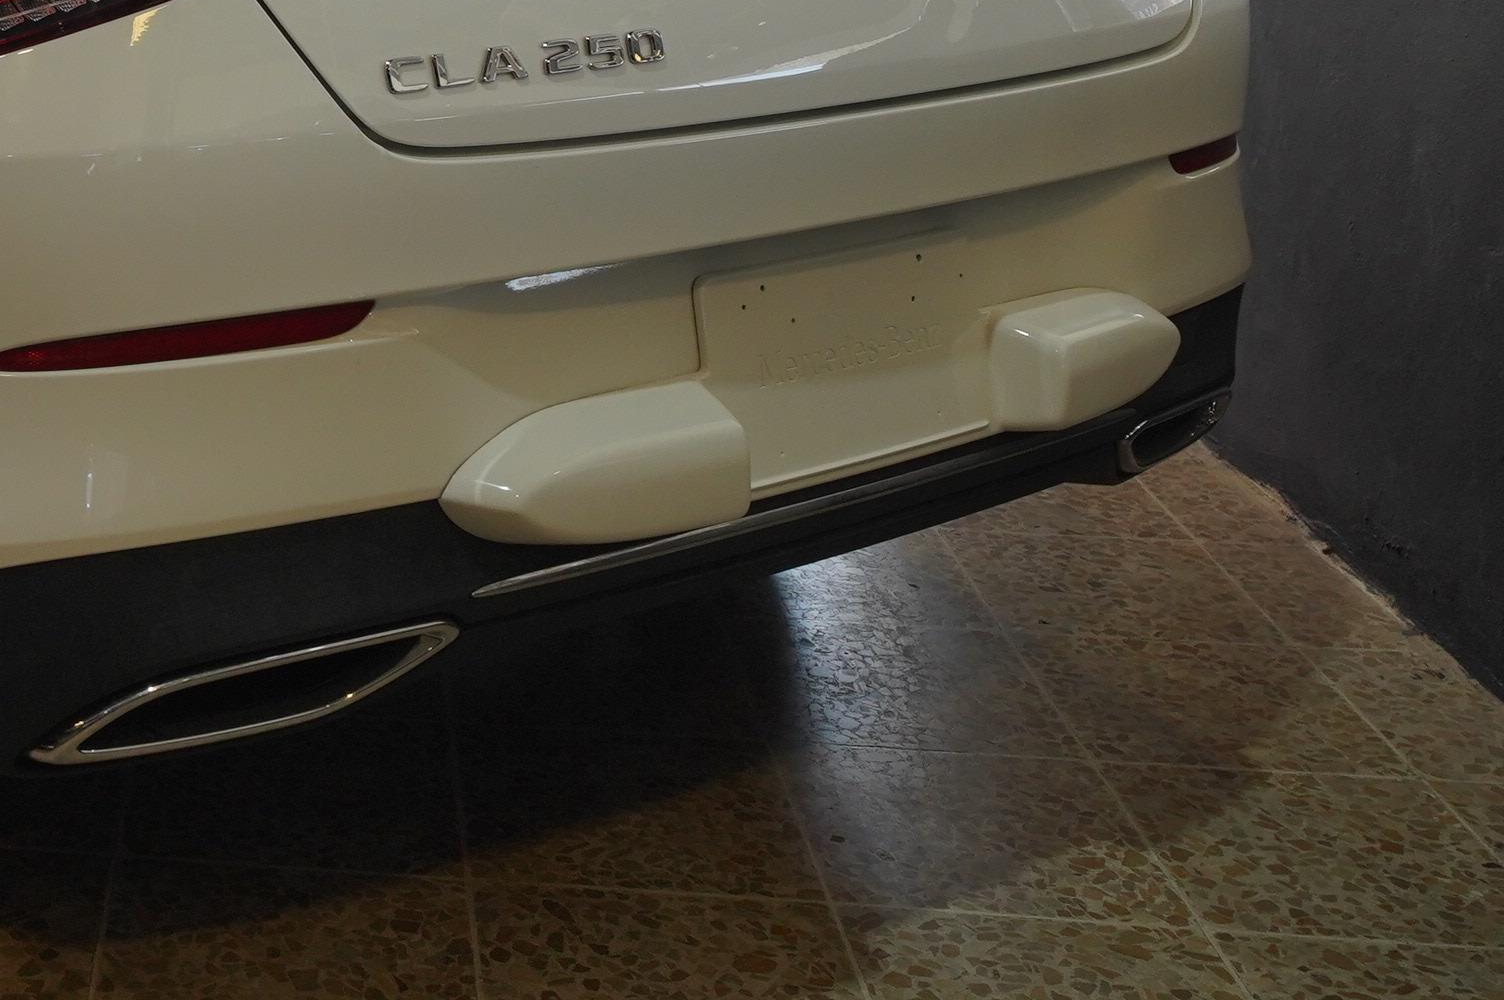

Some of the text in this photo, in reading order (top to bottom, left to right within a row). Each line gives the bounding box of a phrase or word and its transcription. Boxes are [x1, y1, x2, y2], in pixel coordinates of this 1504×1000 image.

[383, 30, 667, 95] CLA 250
[756, 323, 944, 389] Mercedes-Benz
